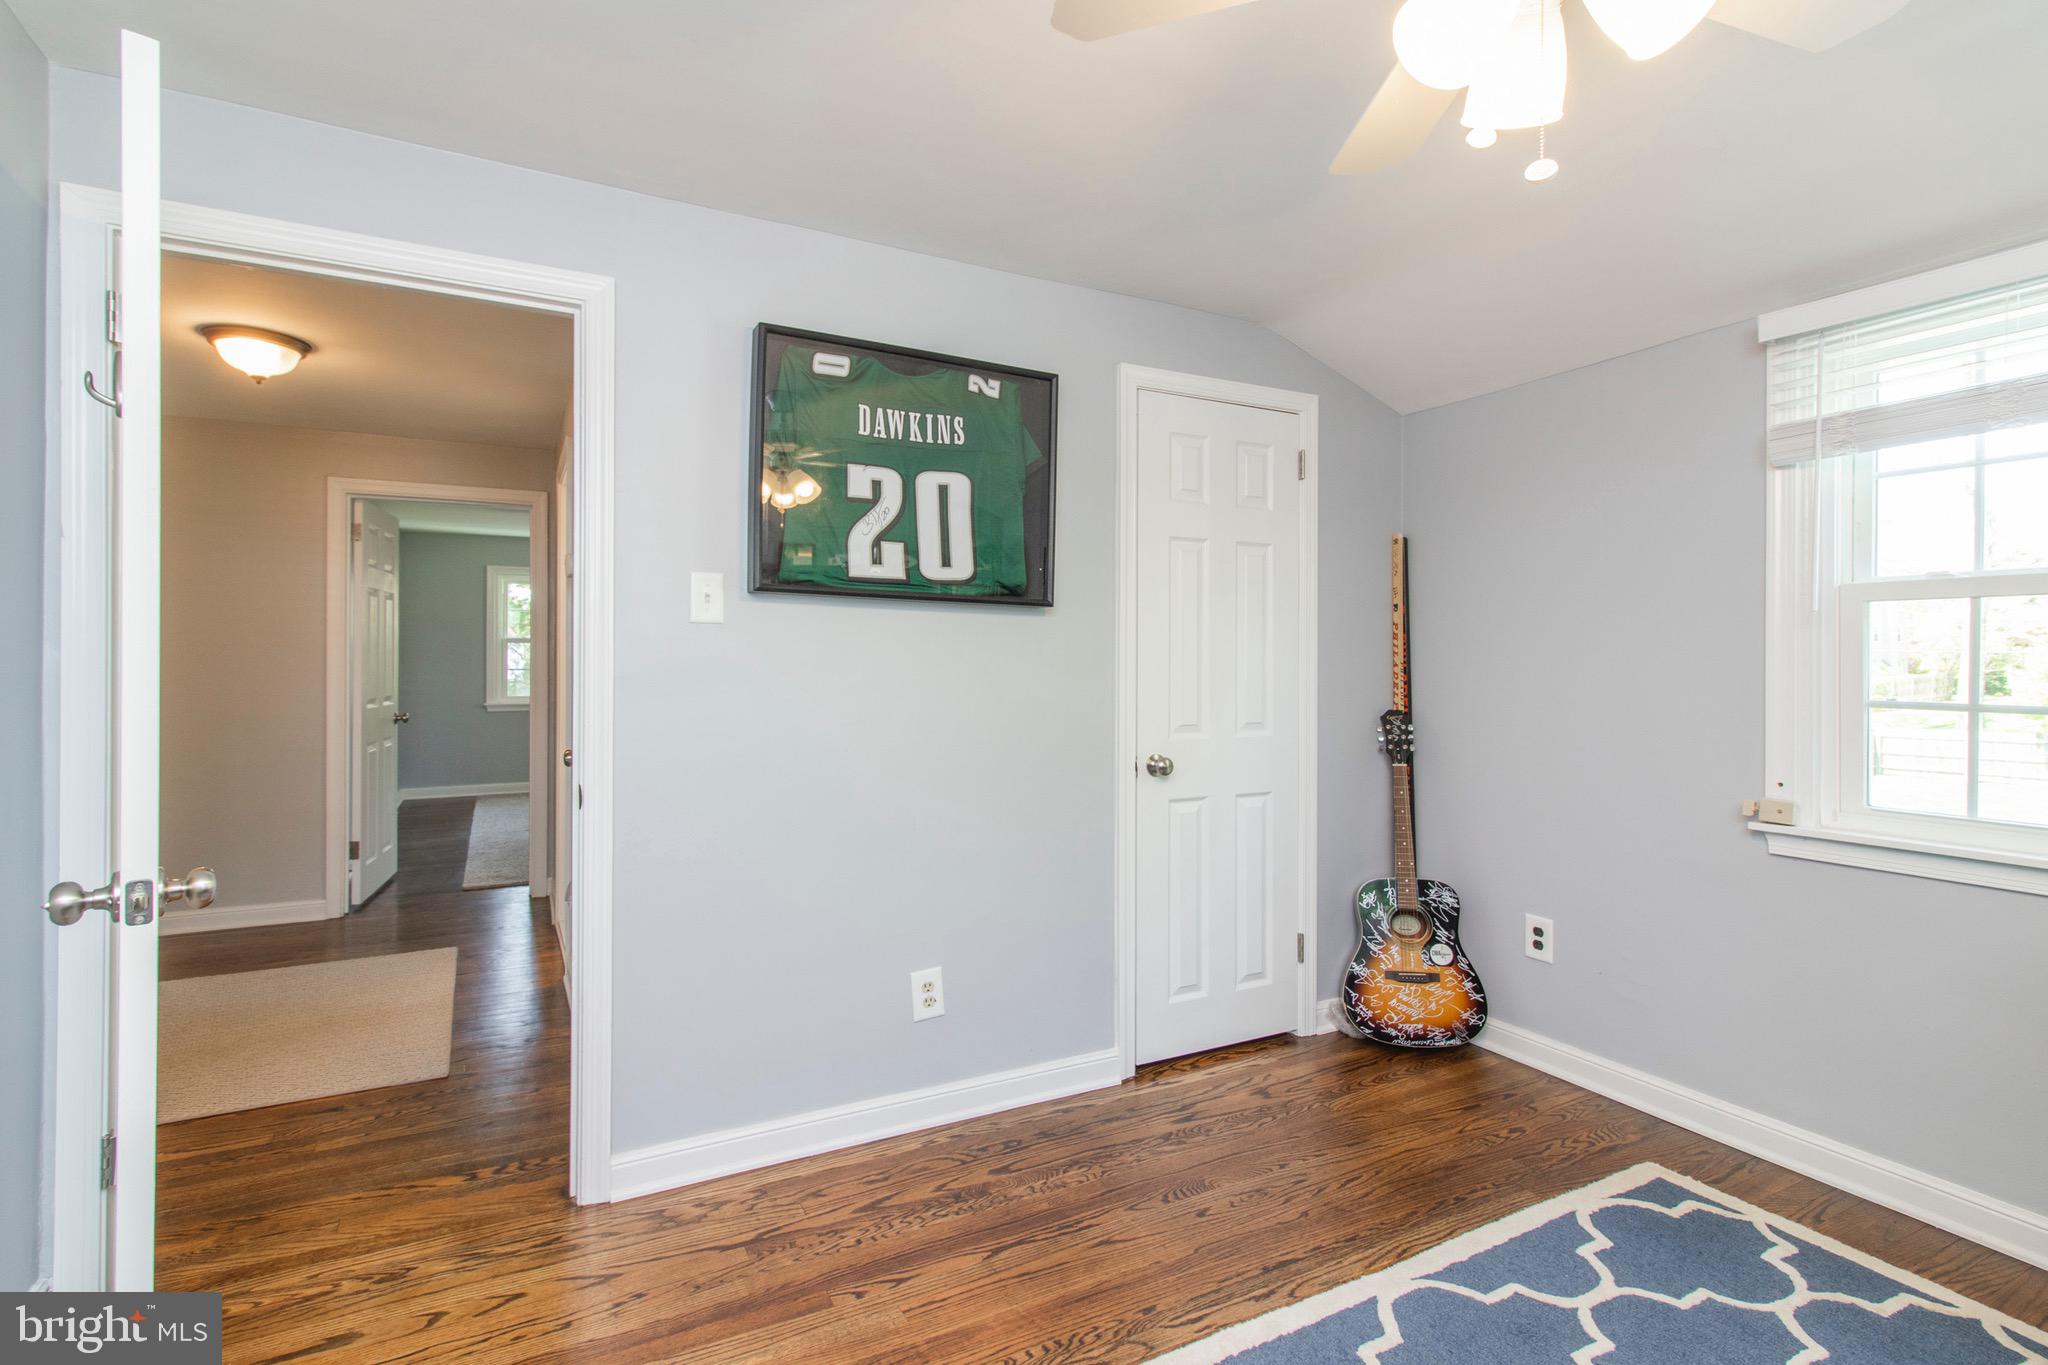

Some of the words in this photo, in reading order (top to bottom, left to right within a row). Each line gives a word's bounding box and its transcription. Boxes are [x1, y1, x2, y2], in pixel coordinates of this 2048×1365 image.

[968, 374, 1001, 400] 2
[857, 403, 966, 446] DAWKINS
[847, 463, 975, 582] 20
